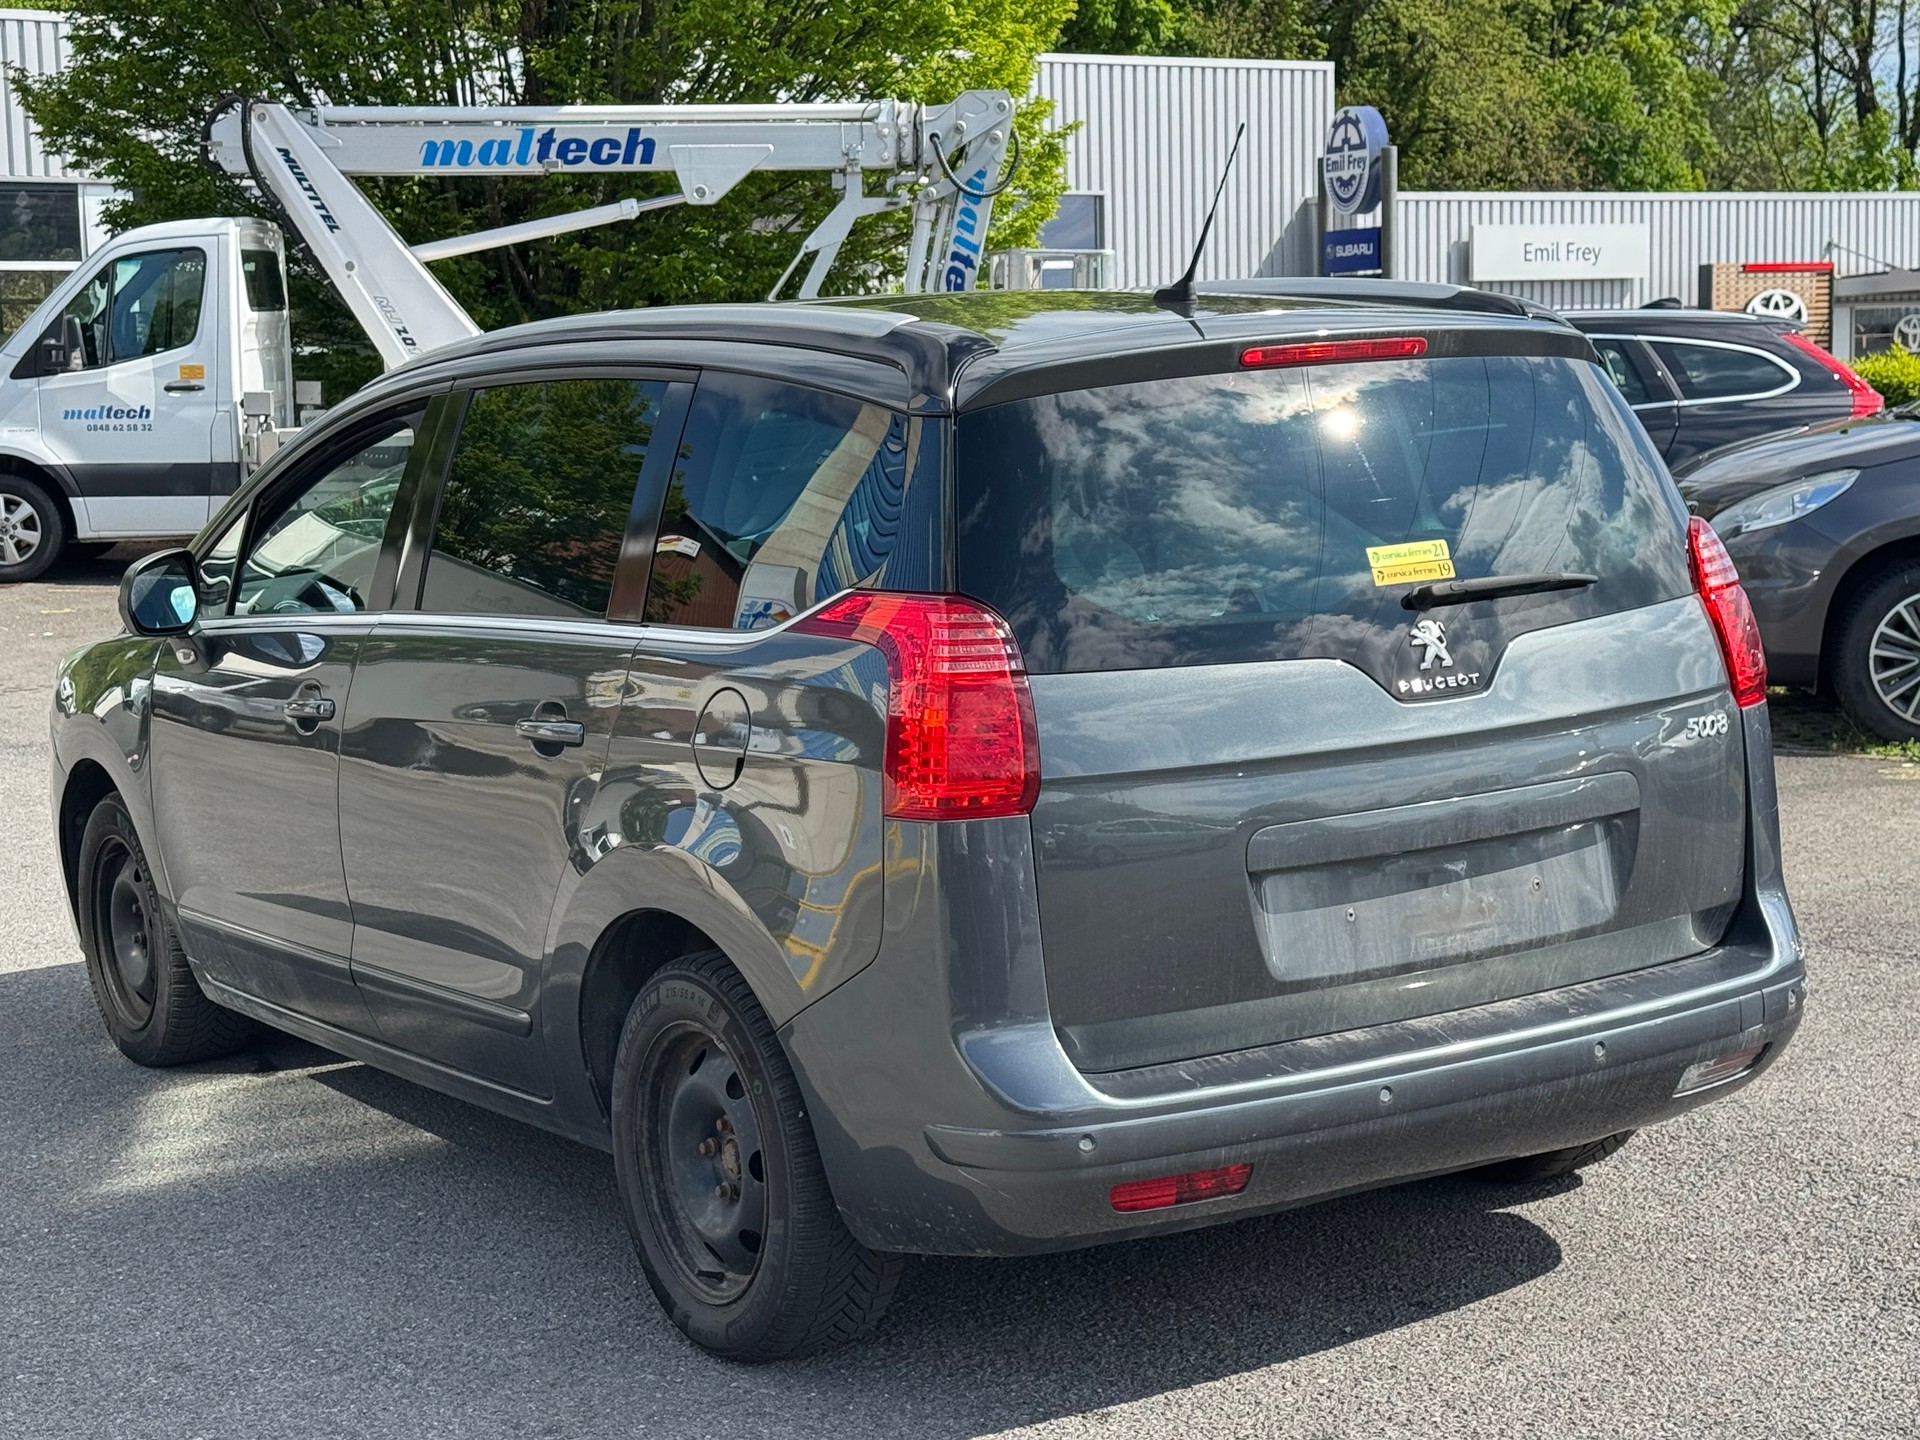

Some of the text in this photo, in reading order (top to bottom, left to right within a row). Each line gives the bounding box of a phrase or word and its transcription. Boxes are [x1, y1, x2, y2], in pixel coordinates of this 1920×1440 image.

[419, 128, 657, 167] maltech
[1326, 154, 1368, 173] Emil Frey
[275, 147, 341, 234] MULTITEL
[1335, 242, 1374, 257] SUBARU
[1523, 241, 1602, 266] Emil Frey
[63, 405, 151, 420] maltech
[86, 423, 153, 432] 0848 62 58 32
[1381, 543, 1445, 560] corsica ferries 21
[1387, 562, 1451, 579] corsica ferries 19
[1398, 672, 1480, 693] PEUGEOT
[1686, 713, 1729, 739] 5008
[666, 986, 689, 1000] 215/55
